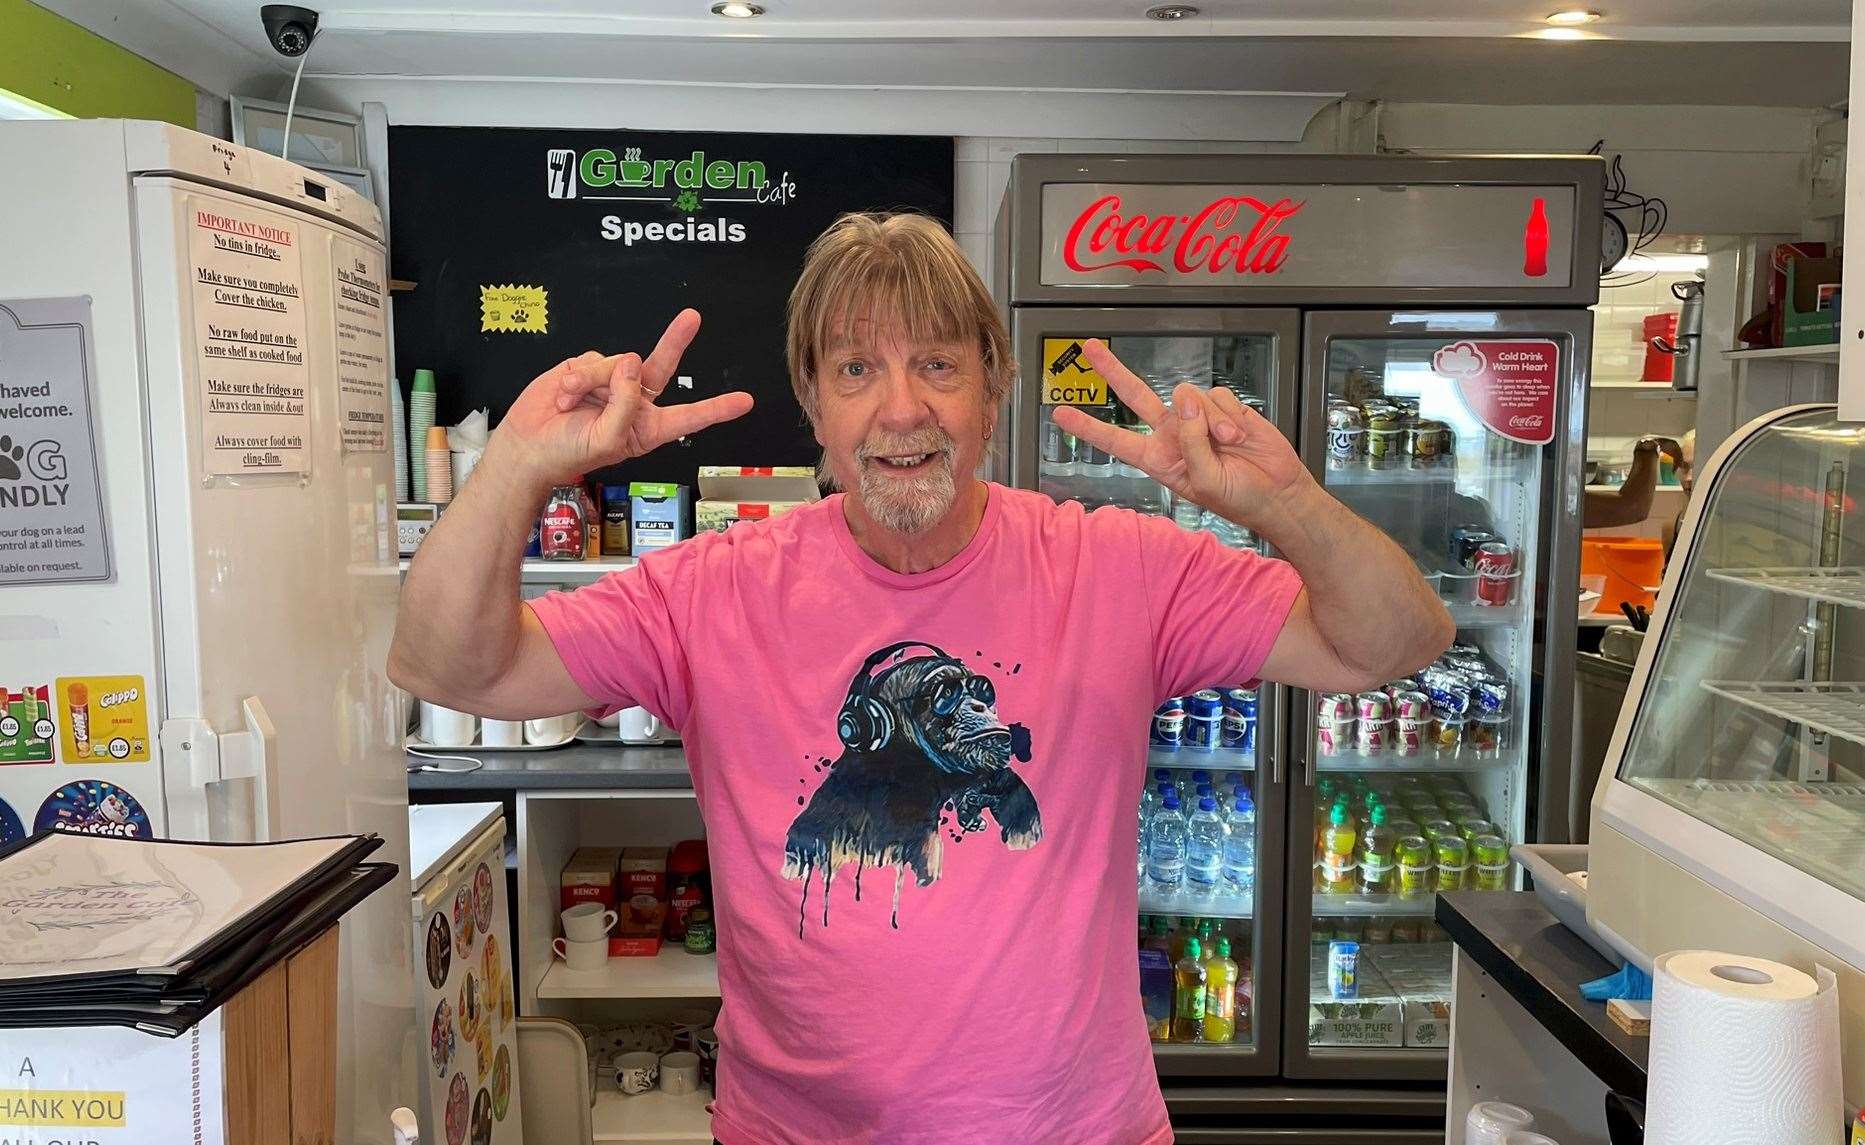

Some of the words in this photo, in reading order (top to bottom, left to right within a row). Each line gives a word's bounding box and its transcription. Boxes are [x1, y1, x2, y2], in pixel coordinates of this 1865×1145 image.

[223, 160, 231, 175] 4
[196, 211, 257, 236] IMPORTANT
[258, 224, 292, 245] NOTICE
[600, 215, 747, 246] Specials
[1063, 194, 1307, 274] Coca-Cola
[213, 233, 227, 247] No
[228, 237, 243, 250] tins
[245, 240, 254, 252] in
[197, 266, 222, 284] Make
[223, 274, 241, 287] sure
[243, 278, 258, 291] you
[259, 280, 299, 298] completely
[214, 288, 240, 304] Cover
[242, 293, 255, 306] the
[256, 296, 287, 311] chicken.
[208, 324, 221, 337] No
[223, 328, 239, 339] raw
[240, 328, 259, 342] food
[260, 333, 273, 344] put
[274, 335, 284, 344] on
[285, 334, 298, 346] the
[204, 344, 227, 356] same
[228, 344, 248, 358] shelf
[248, 349, 258, 359] as
[259, 350, 285, 362] cooked
[286, 351, 303, 364] food
[1498, 351, 1519, 361] Cold
[1520, 351, 1544, 361] Drink
[1492, 362, 1520, 371] Warm
[1522, 362, 1549, 371] Heart
[208, 379, 232, 393] Make
[233, 384, 251, 394] sure
[252, 383, 265, 394] the
[266, 383, 291, 397] fridges
[292, 387, 304, 397] are
[1050, 387, 1099, 402] CCTV
[209, 398, 240, 412] Always
[241, 400, 262, 412] clean
[263, 400, 284, 413] inside
[1508, 415, 1544, 428] Coca-Cola
[214, 435, 245, 448] Always
[246, 438, 268, 448] cover
[270, 435, 286, 447] food
[287, 434, 302, 447] with
[242, 452, 282, 469] cling-film.
[20, 527, 40, 539] dog
[41, 528, 54, 536] on
[55, 527, 62, 535] a
[63, 524, 85, 535] lead
[639, 521, 657, 529] DECAF
[29, 540, 40, 550] at
[41, 538, 53, 549] all
[26, 563, 40, 572] on
[99, 687, 139, 709] Calippo
[111, 744, 128, 752] £1.85
[631, 874, 657, 882] KENCO
[573, 887, 600, 896] KENCO
[1332, 1023, 1360, 1032] 100%
[1364, 1023, 1393, 1032] PURE
[19, 1056, 36, 1077] A
[72, 1099, 124, 1120] YOU
